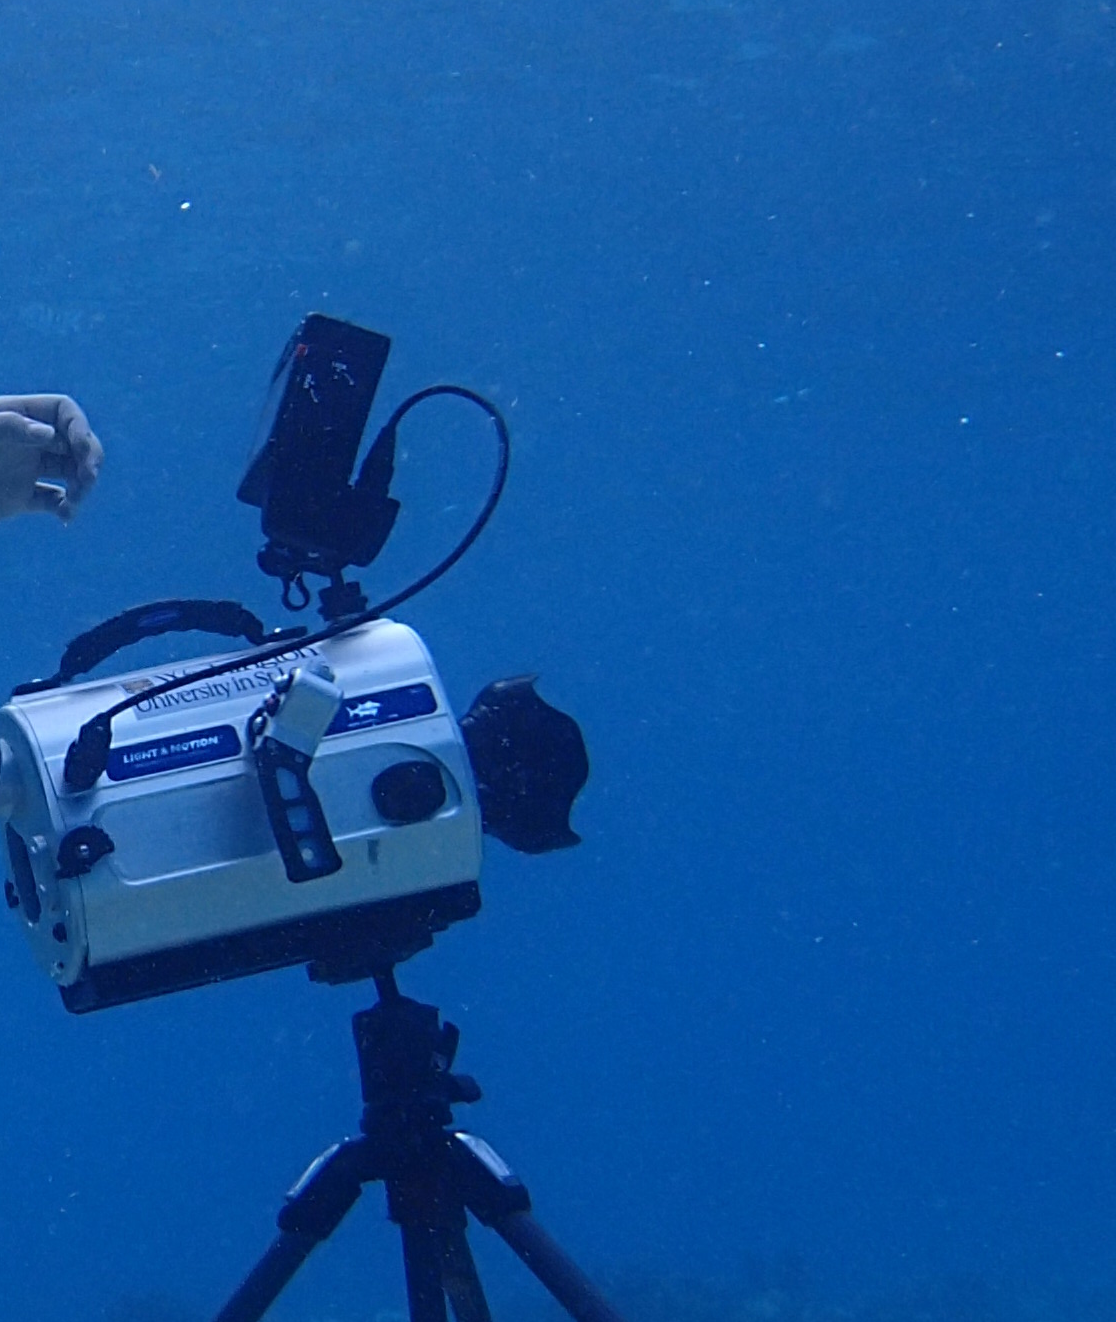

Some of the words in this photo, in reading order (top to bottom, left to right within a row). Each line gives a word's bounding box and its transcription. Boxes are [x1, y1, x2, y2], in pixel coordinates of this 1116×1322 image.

[136, 680, 231, 713] University
[231, 675, 255, 692] in
[123, 748, 158, 764] LIGHT
[170, 735, 219, 753] MOTION
